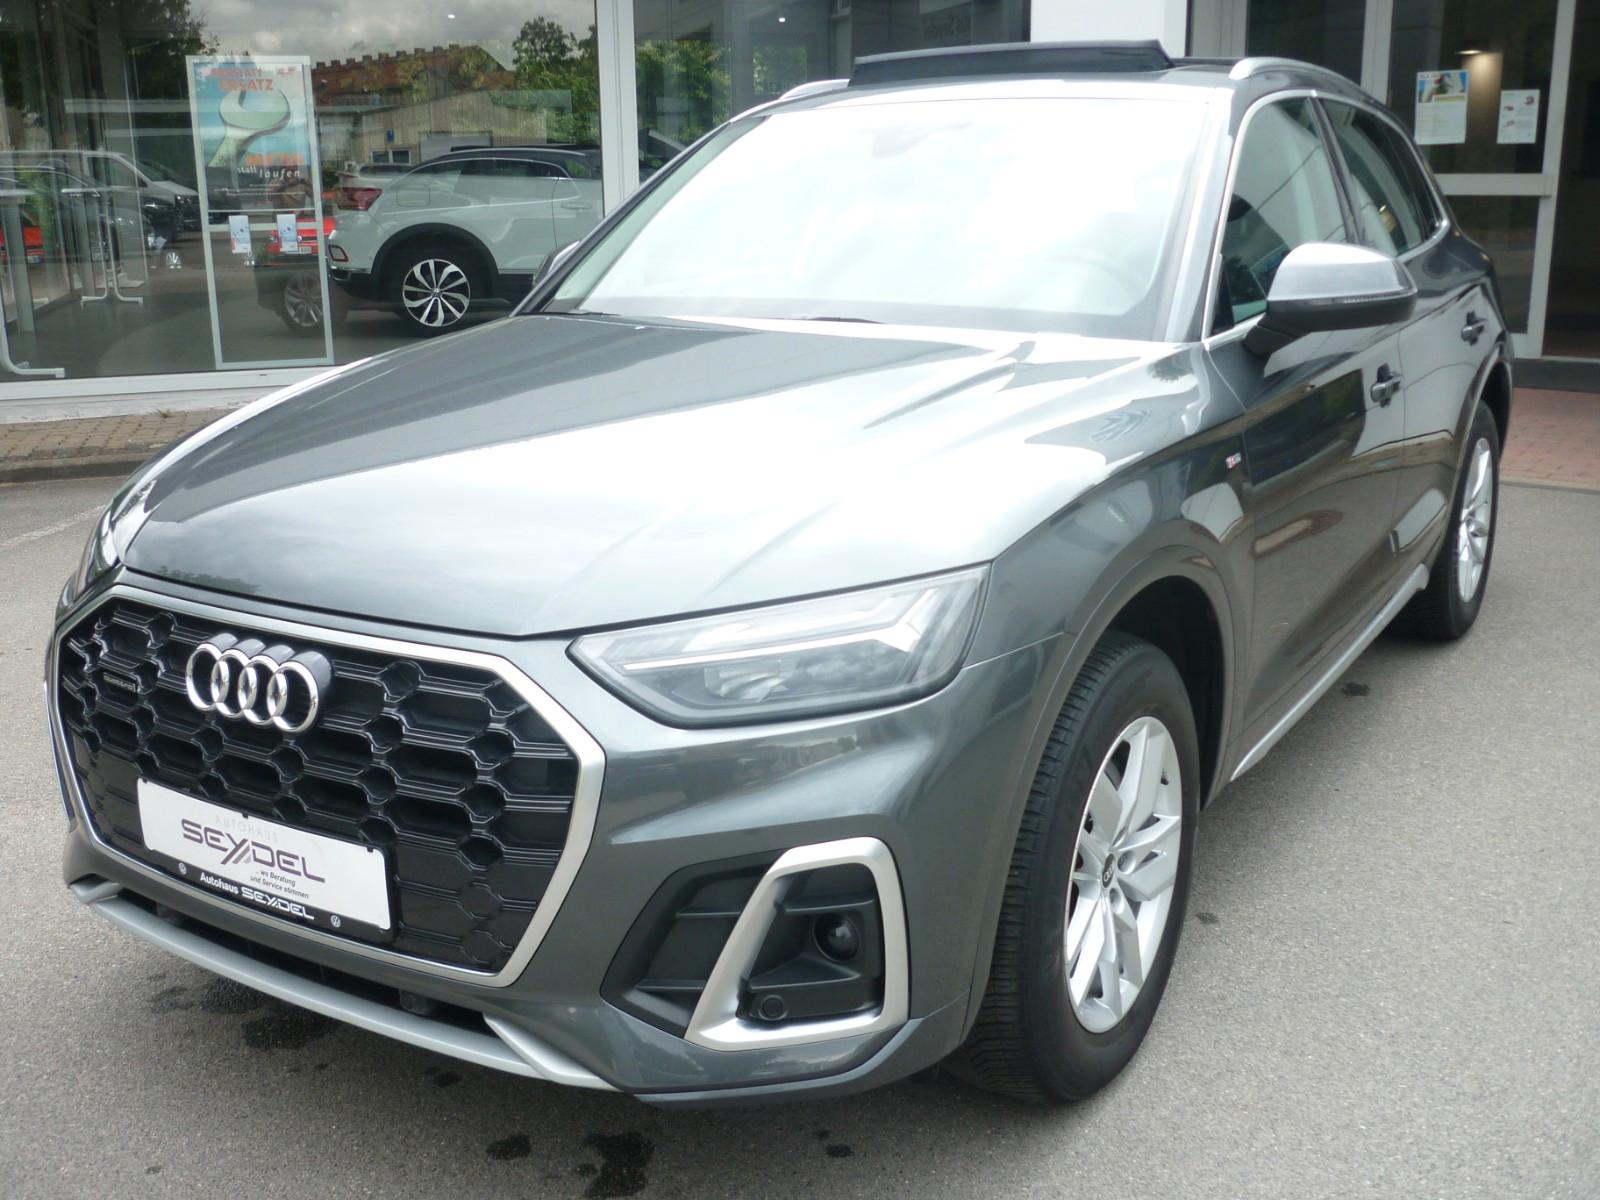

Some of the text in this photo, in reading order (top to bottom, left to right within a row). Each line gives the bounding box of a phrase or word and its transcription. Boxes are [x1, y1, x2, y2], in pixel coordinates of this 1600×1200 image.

[259, 168, 301, 180] laufen
[215, 815, 279, 843] AUTOHAUS
[181, 818, 326, 883] SEYDEL
[262, 878, 283, 891] Service
[270, 871, 296, 887] Beratung
[200, 872, 315, 920] Autohaus SEYDEL
